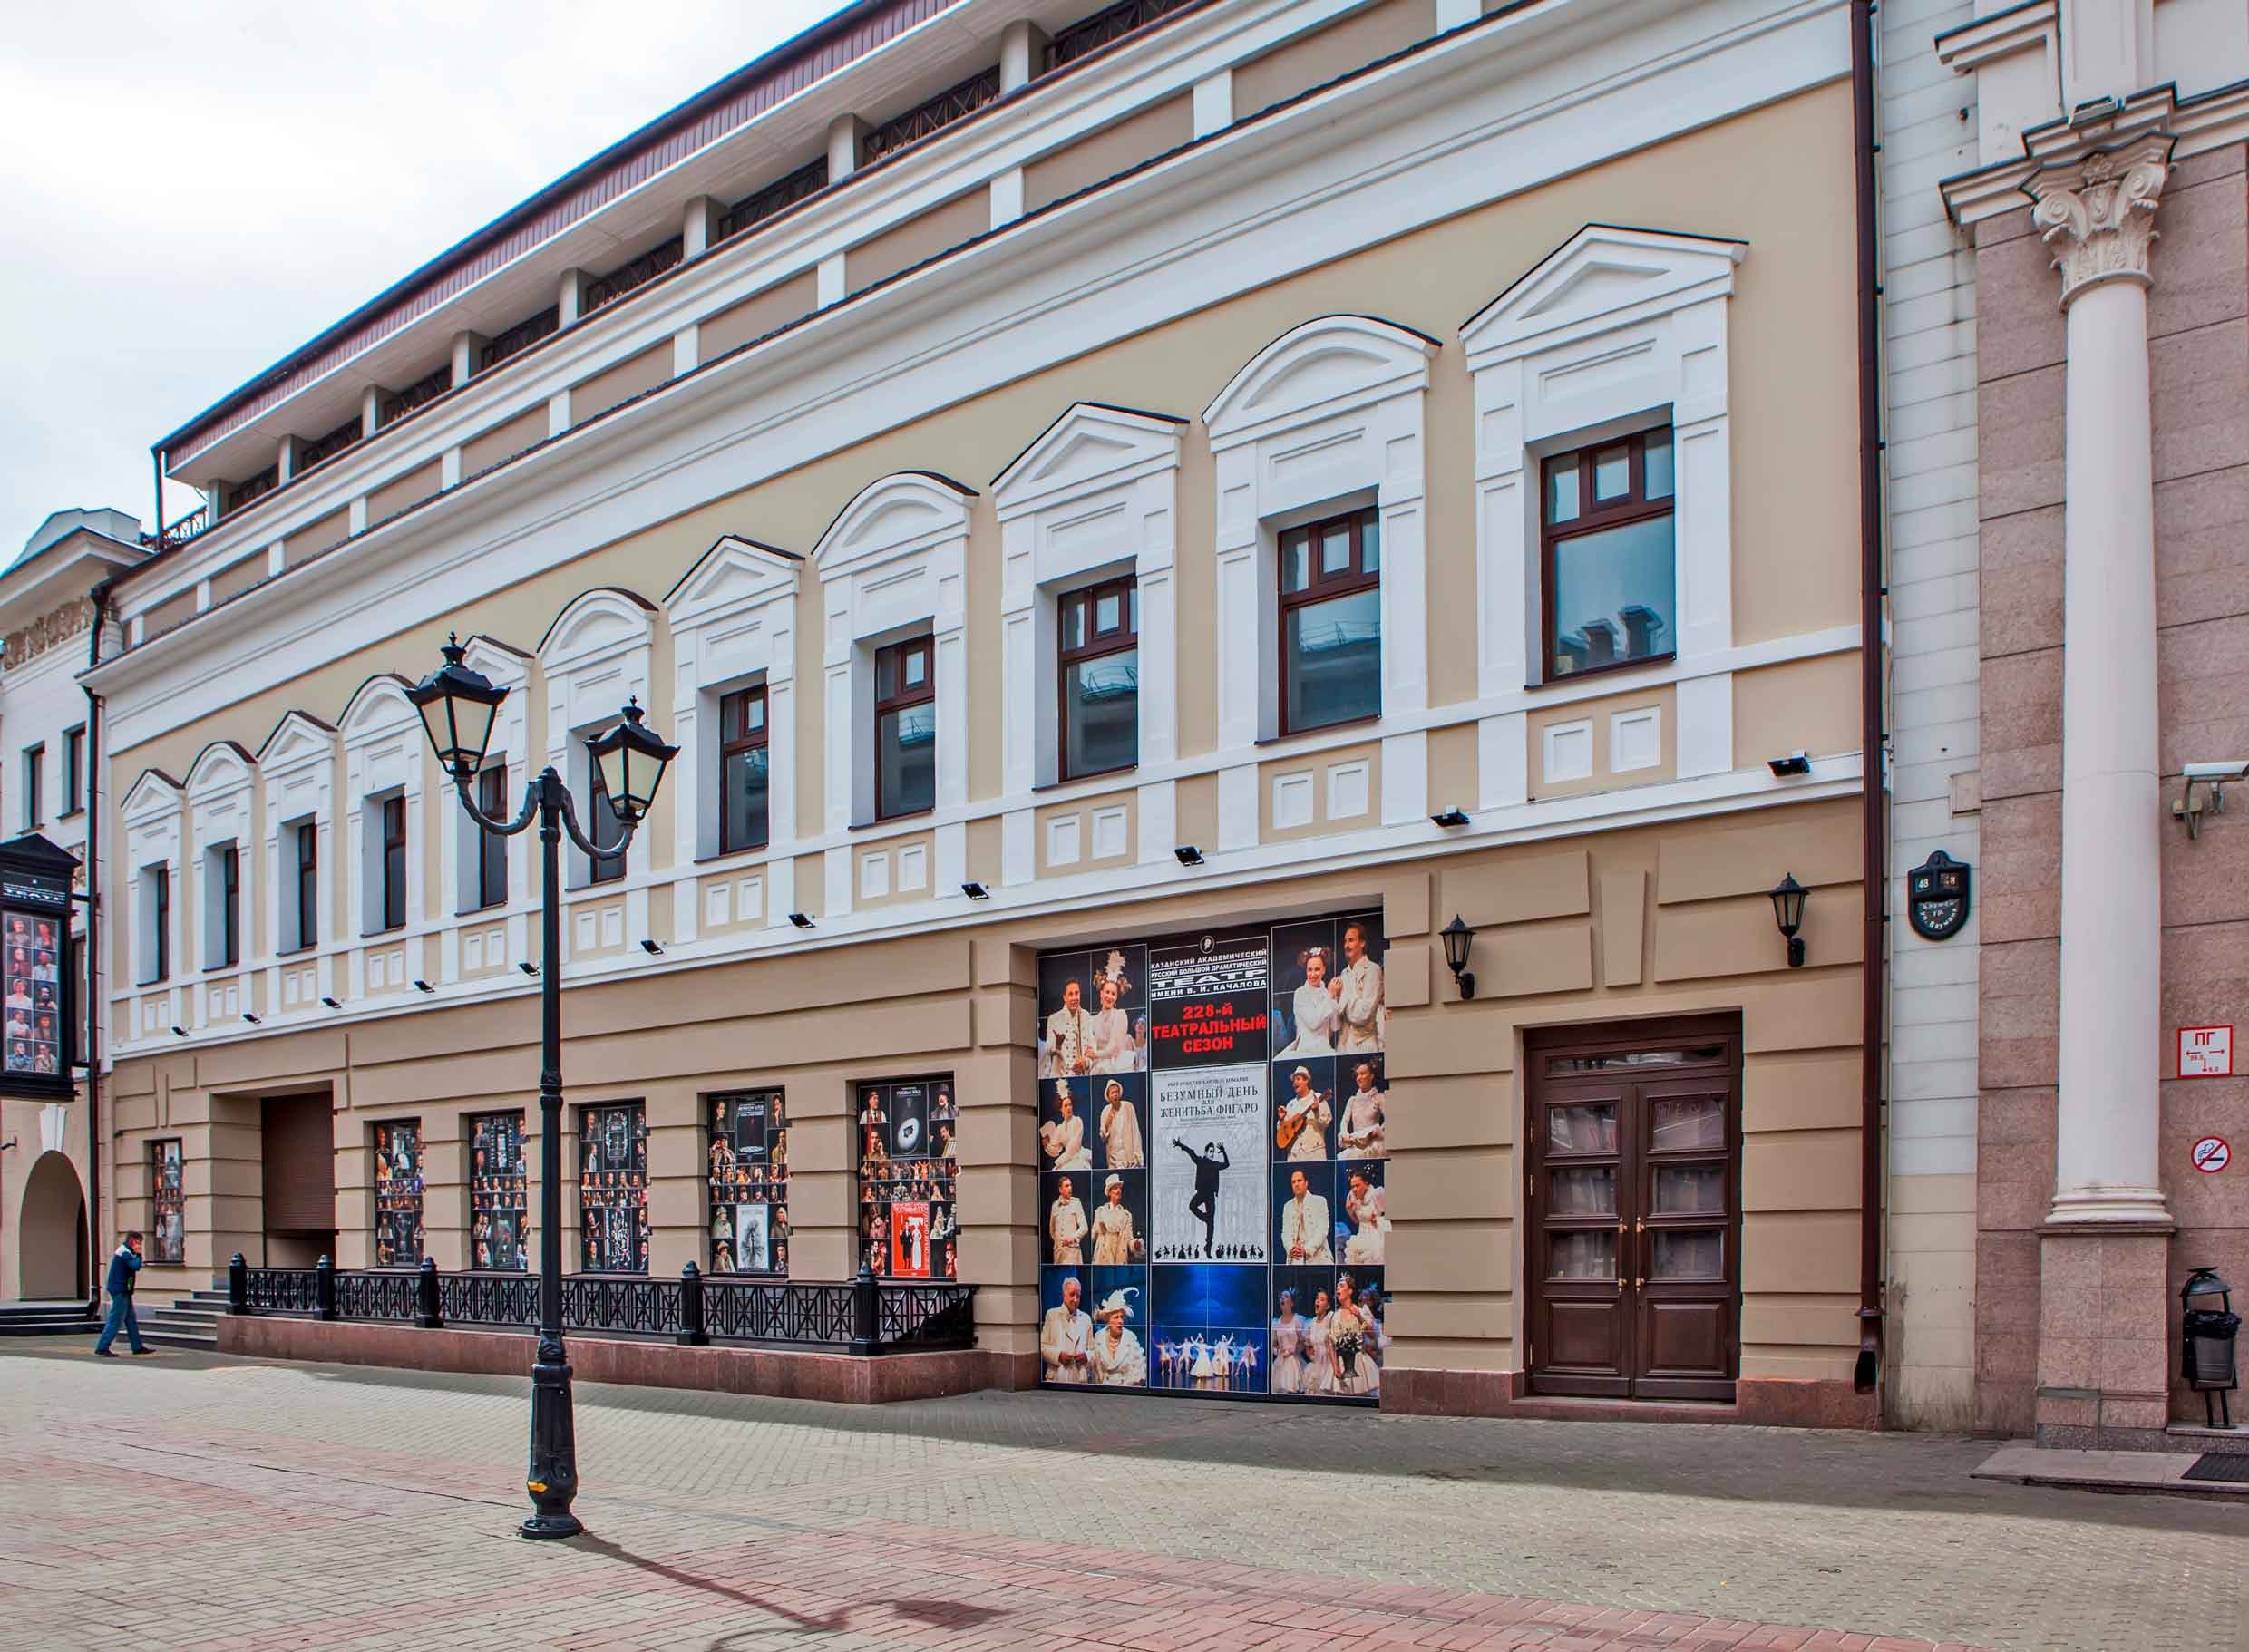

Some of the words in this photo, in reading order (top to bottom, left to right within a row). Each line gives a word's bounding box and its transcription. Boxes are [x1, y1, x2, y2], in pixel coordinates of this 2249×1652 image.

[1151, 957, 1195, 969] КАЗАНСКИЙ
[1197, 948, 1267, 964] АКАДЕМИЧЕСКИЙ
[1151, 968, 1178, 978] РУССКИЙ
[1179, 964, 1211, 976] БОЛЬШОЙ
[1212, 958, 1267, 972] ДРАМАТИЧЕСКИЙ
[1151, 969, 1267, 988] ТЕАТР
[1151, 988, 1183, 998] ИМЕНИ
[1186, 986, 1196, 995] В.
[1200, 985, 1211, 993] И.
[1213, 979, 1267, 992] КАЧАЛОВА
[1152, 1013, 1267, 1040] ТЕАТРАЛЬНЫЙ
[1183, 1036, 1234, 1054] СЕЗОН
[2195, 1031, 2215, 1045] ПГ
[1160, 1086, 1222, 1102] БЕЗУМНЫЙ
[1227, 1086, 1258, 1098] ДЕНЬ
[1160, 1105, 1213, 1118] ЖЕНИТЬБА
[1216, 1103, 1258, 1113] ФИГАРО
